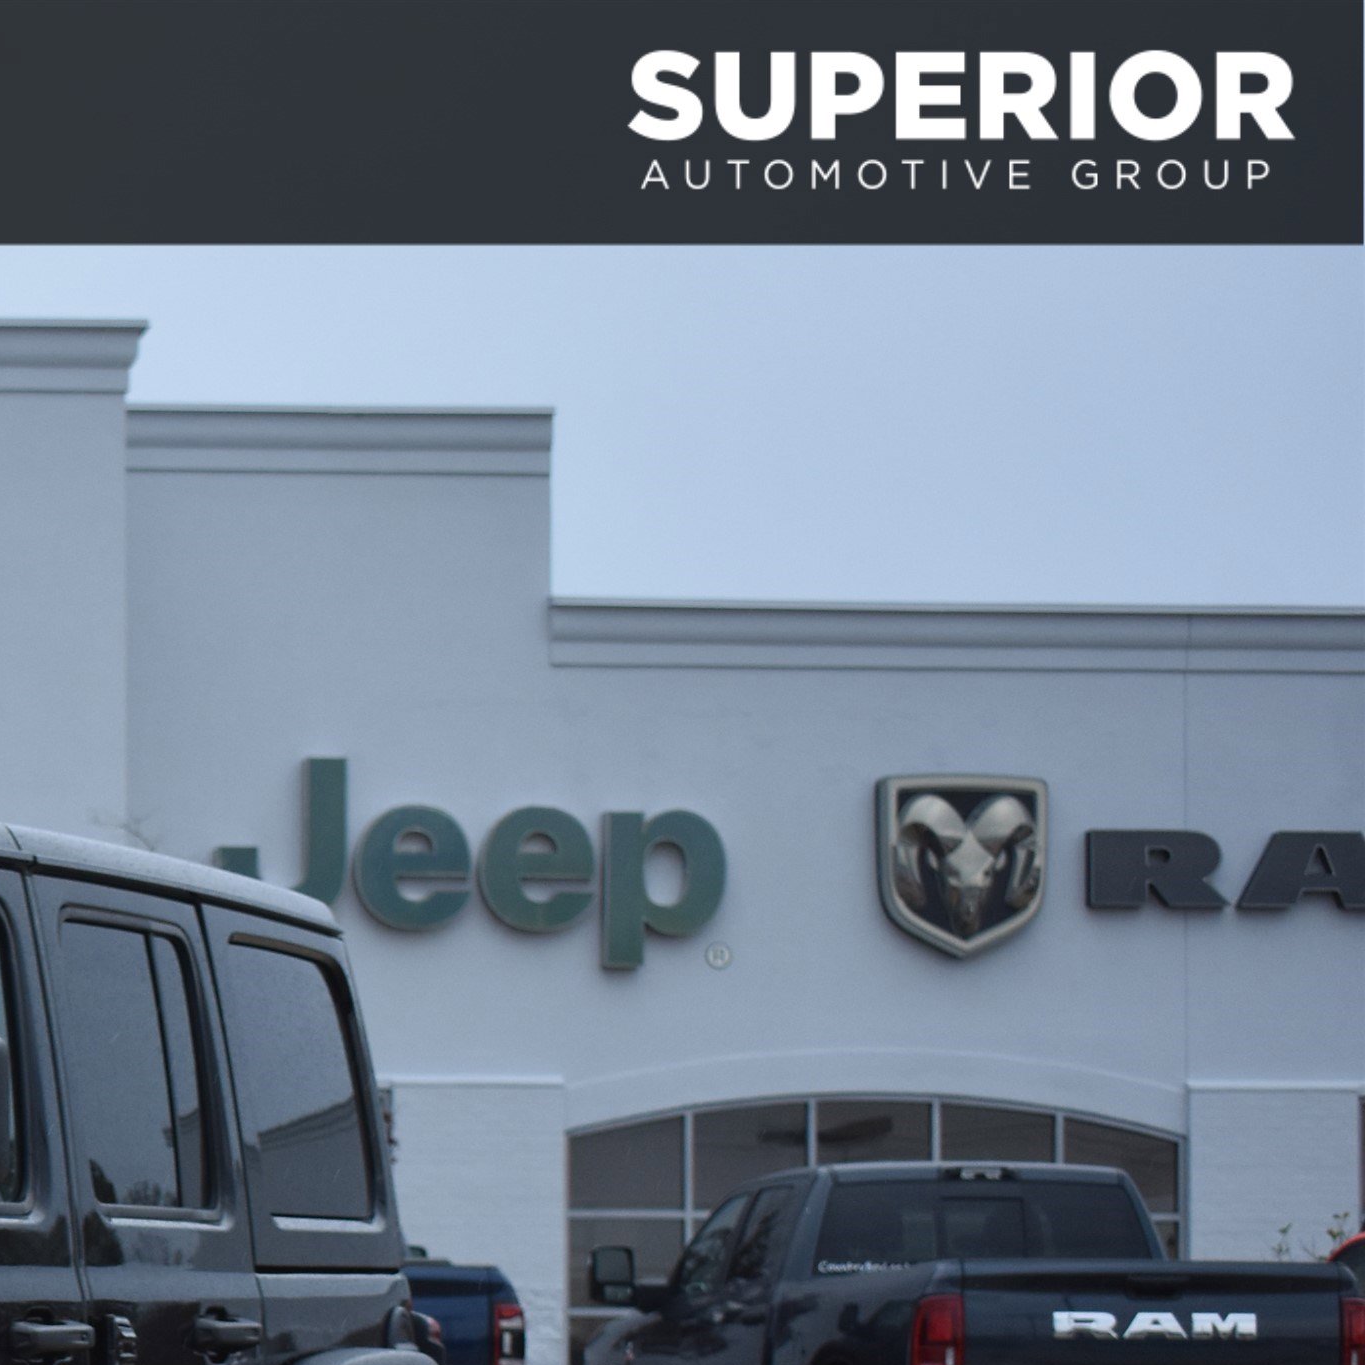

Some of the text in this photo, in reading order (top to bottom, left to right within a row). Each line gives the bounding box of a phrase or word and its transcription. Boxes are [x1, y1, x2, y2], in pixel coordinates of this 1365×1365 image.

[215, 757, 728, 970] Jeep
[1085, 829, 1365, 911] RA
[1052, 1310, 1258, 1341] RAM
